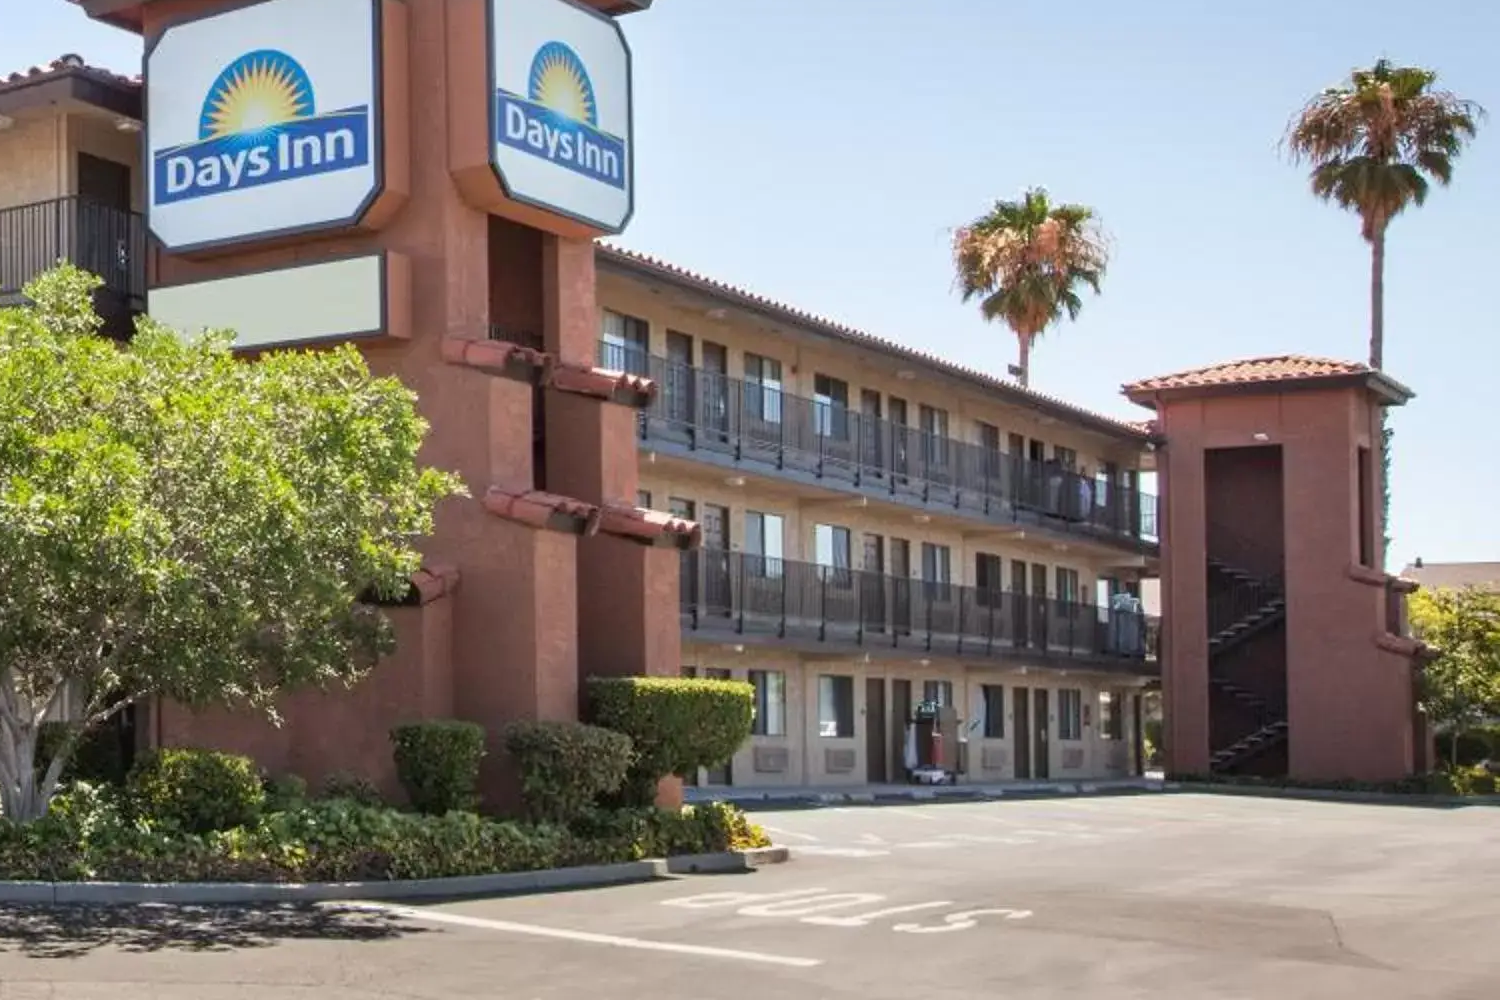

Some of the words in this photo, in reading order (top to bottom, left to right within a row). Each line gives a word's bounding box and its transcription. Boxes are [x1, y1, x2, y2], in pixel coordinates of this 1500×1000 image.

[167, 145, 270, 193] Days
[278, 128, 355, 171] Inn
[505, 102, 574, 160] Days
[577, 131, 619, 179] Inn
[660, 887, 1033, 933] STOP
